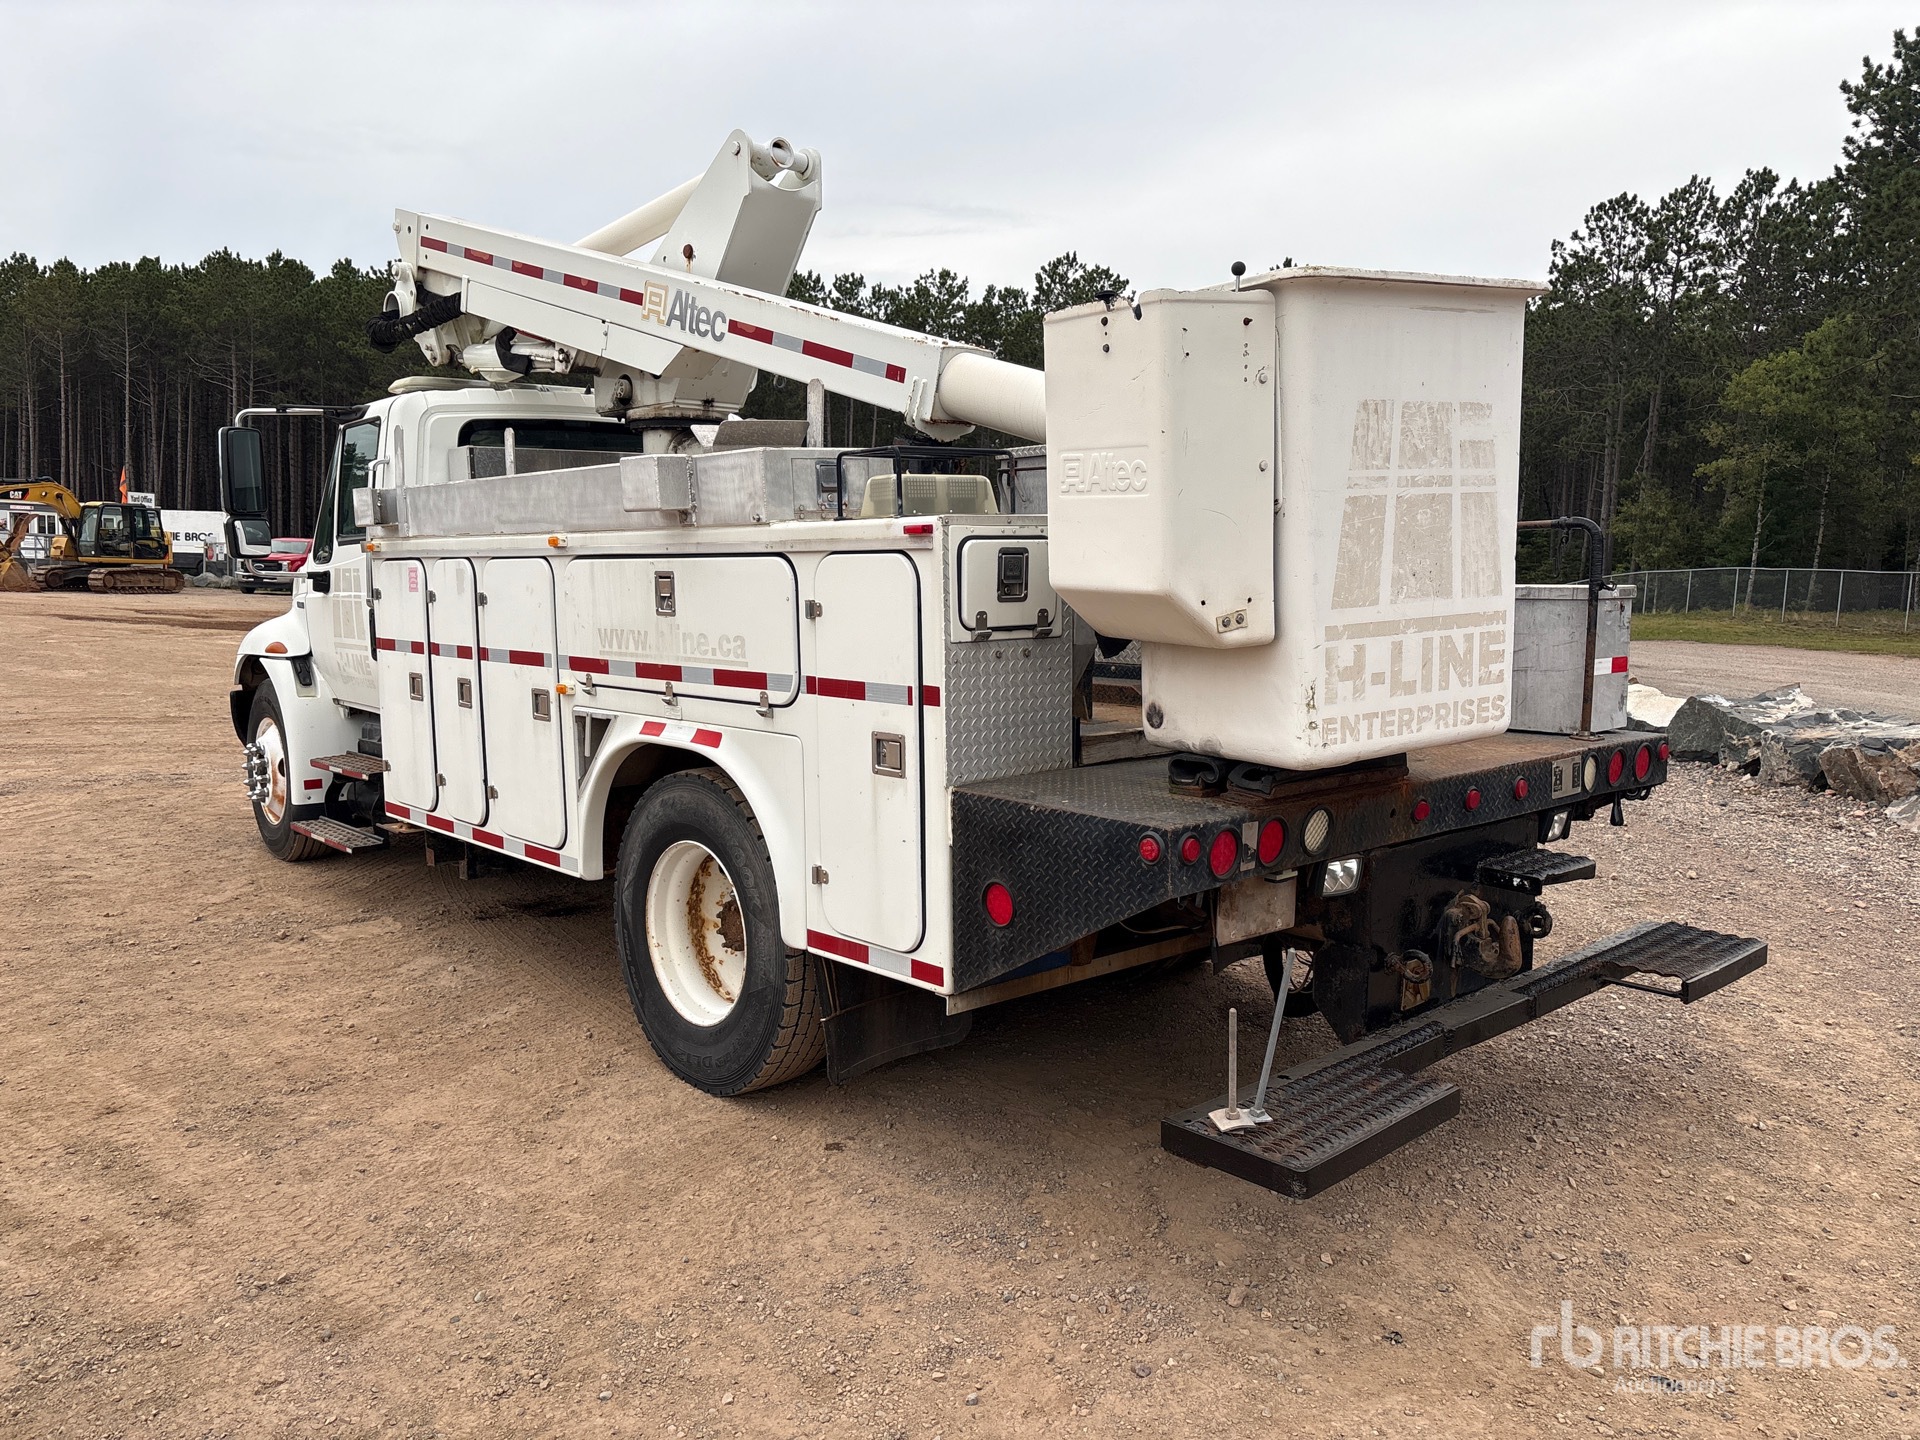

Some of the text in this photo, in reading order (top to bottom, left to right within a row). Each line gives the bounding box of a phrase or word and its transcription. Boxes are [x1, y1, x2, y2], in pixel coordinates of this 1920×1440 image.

[666, 289, 726, 342] Altec
[9, 490, 23, 499] CAT
[1086, 452, 1147, 492] Altec
[130, 494, 153, 504] Yard Office
[1324, 630, 1506, 706] H-LINE
[1321, 694, 1506, 747] ENTERPRISES
